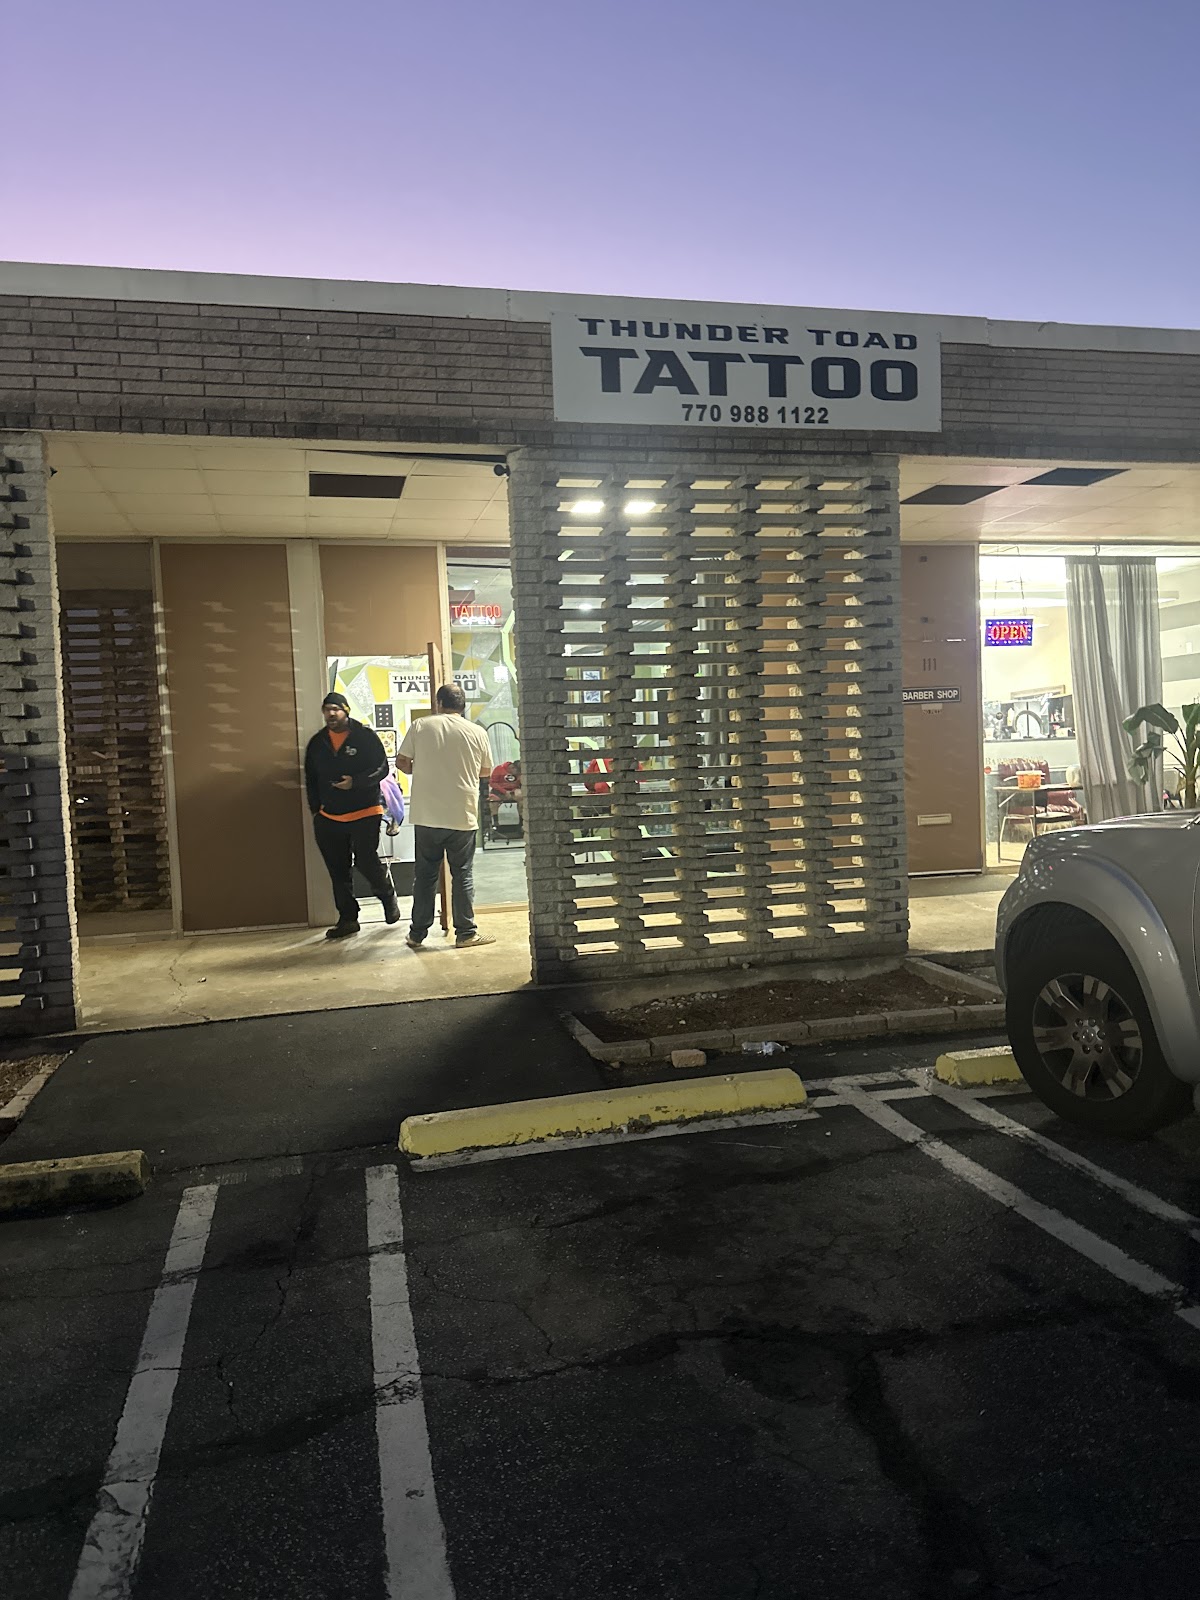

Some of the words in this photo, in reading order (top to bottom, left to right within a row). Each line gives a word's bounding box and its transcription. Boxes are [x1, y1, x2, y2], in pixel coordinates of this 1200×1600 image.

[578, 318, 790, 344] THUNDER
[806, 328, 918, 350] TOAD
[578, 346, 919, 402] TATTOO
[681, 404, 722, 422] 770
[730, 405, 769, 424] 988
[777, 407, 830, 425] 1122
[451, 604, 502, 618] TATTOO
[459, 616, 496, 625] OPEN
[990, 624, 1030, 640] OPEN
[902, 690, 934, 701] BARBER
[937, 689, 959, 699] SHOP
